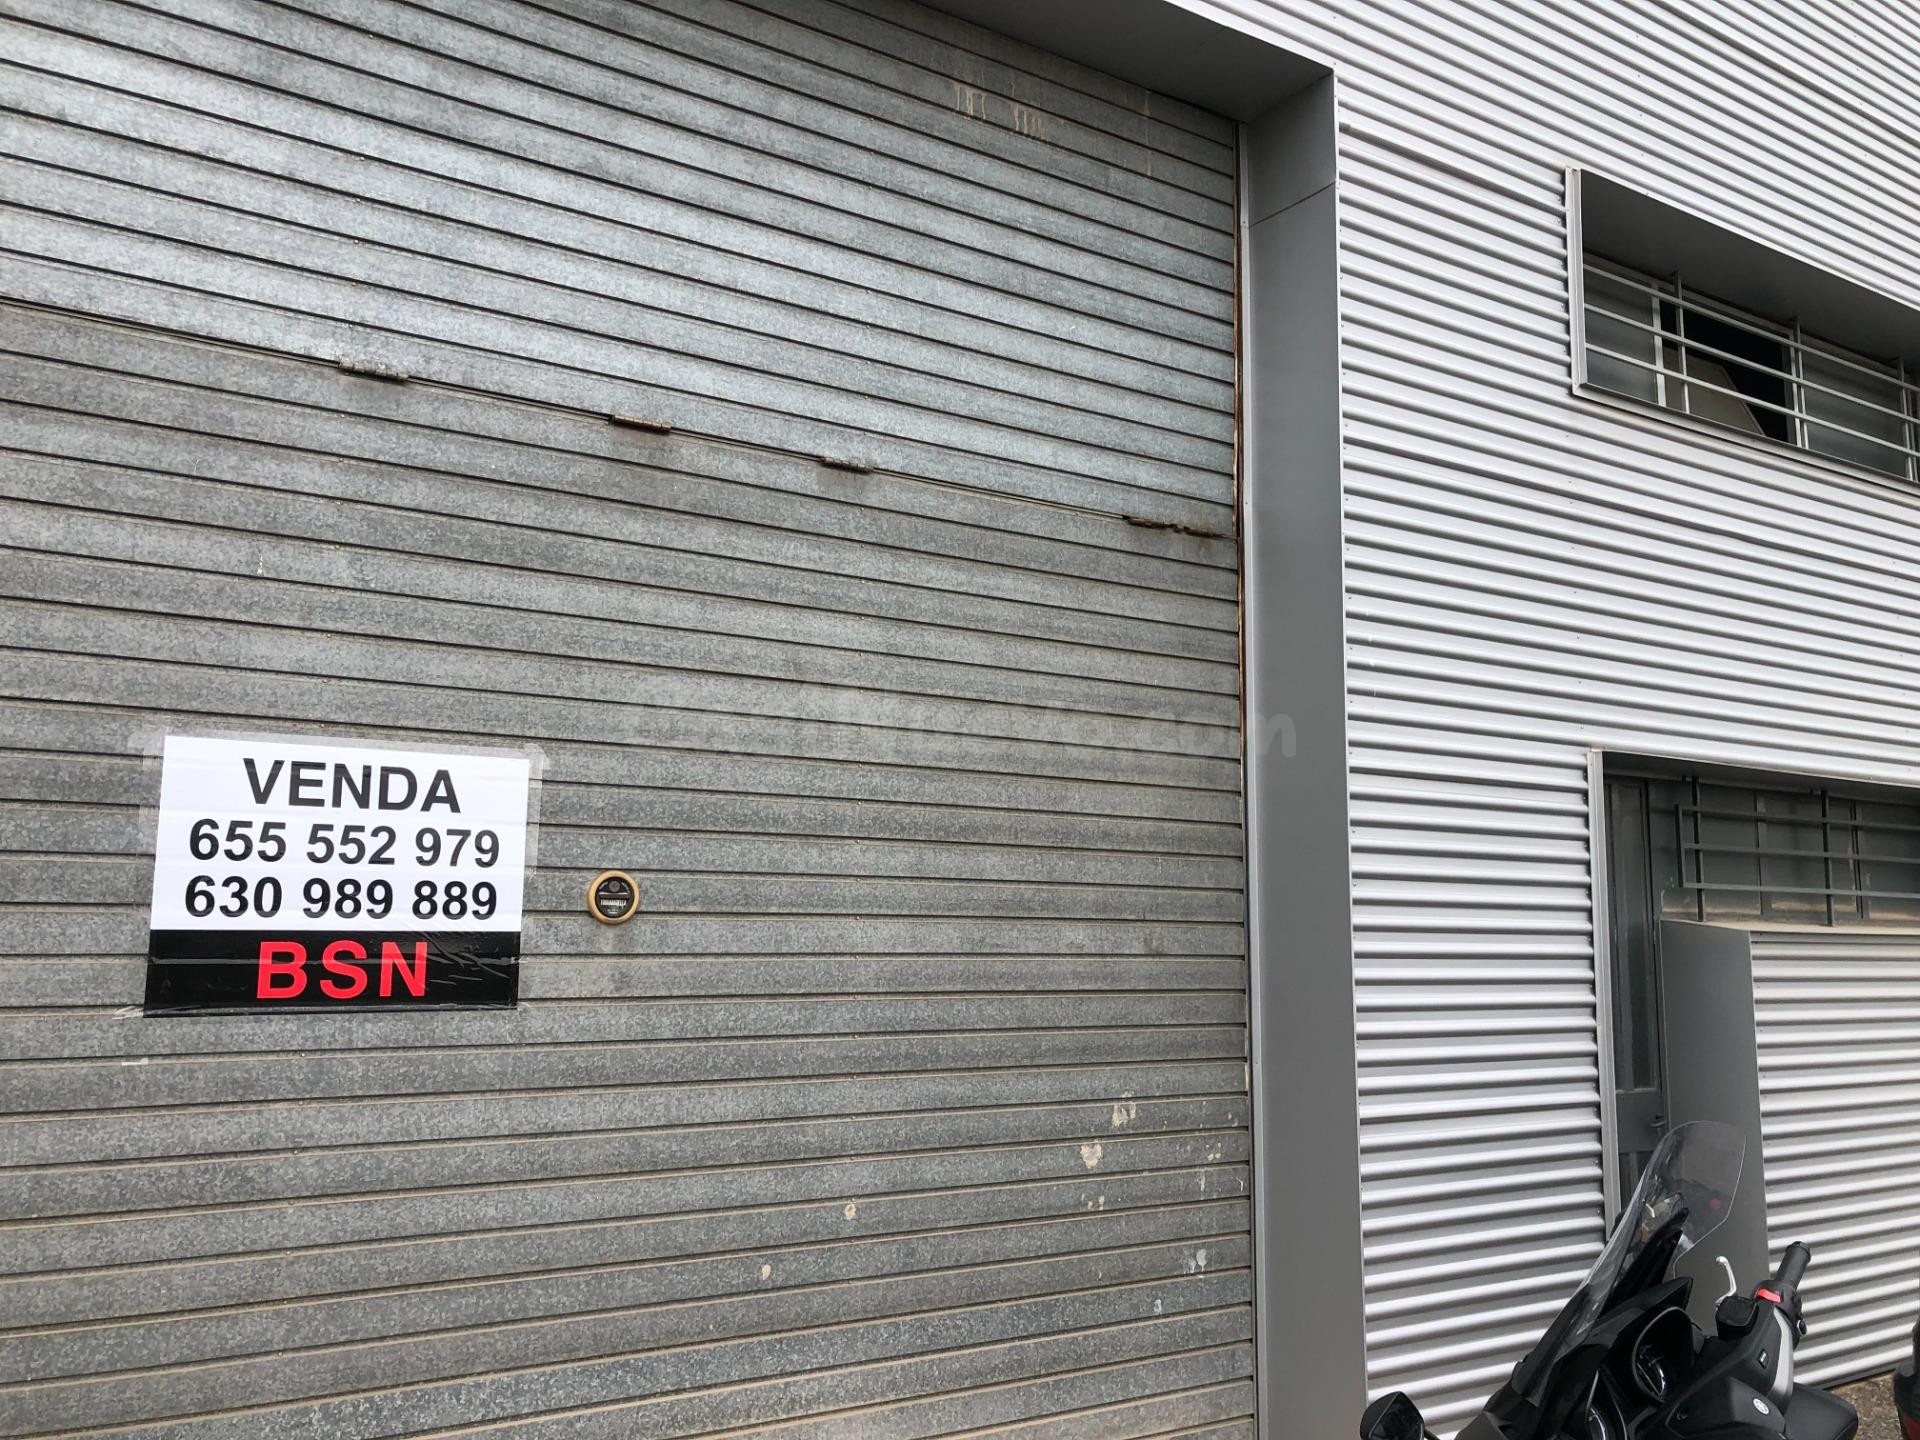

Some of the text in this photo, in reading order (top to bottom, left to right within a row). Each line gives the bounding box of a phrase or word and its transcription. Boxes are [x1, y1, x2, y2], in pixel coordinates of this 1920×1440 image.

[243, 757, 461, 814] VENDA
[189, 818, 500, 868] 655 552 979
[185, 875, 497, 921] 630 989 889
[256, 939, 428, 999] BSN
